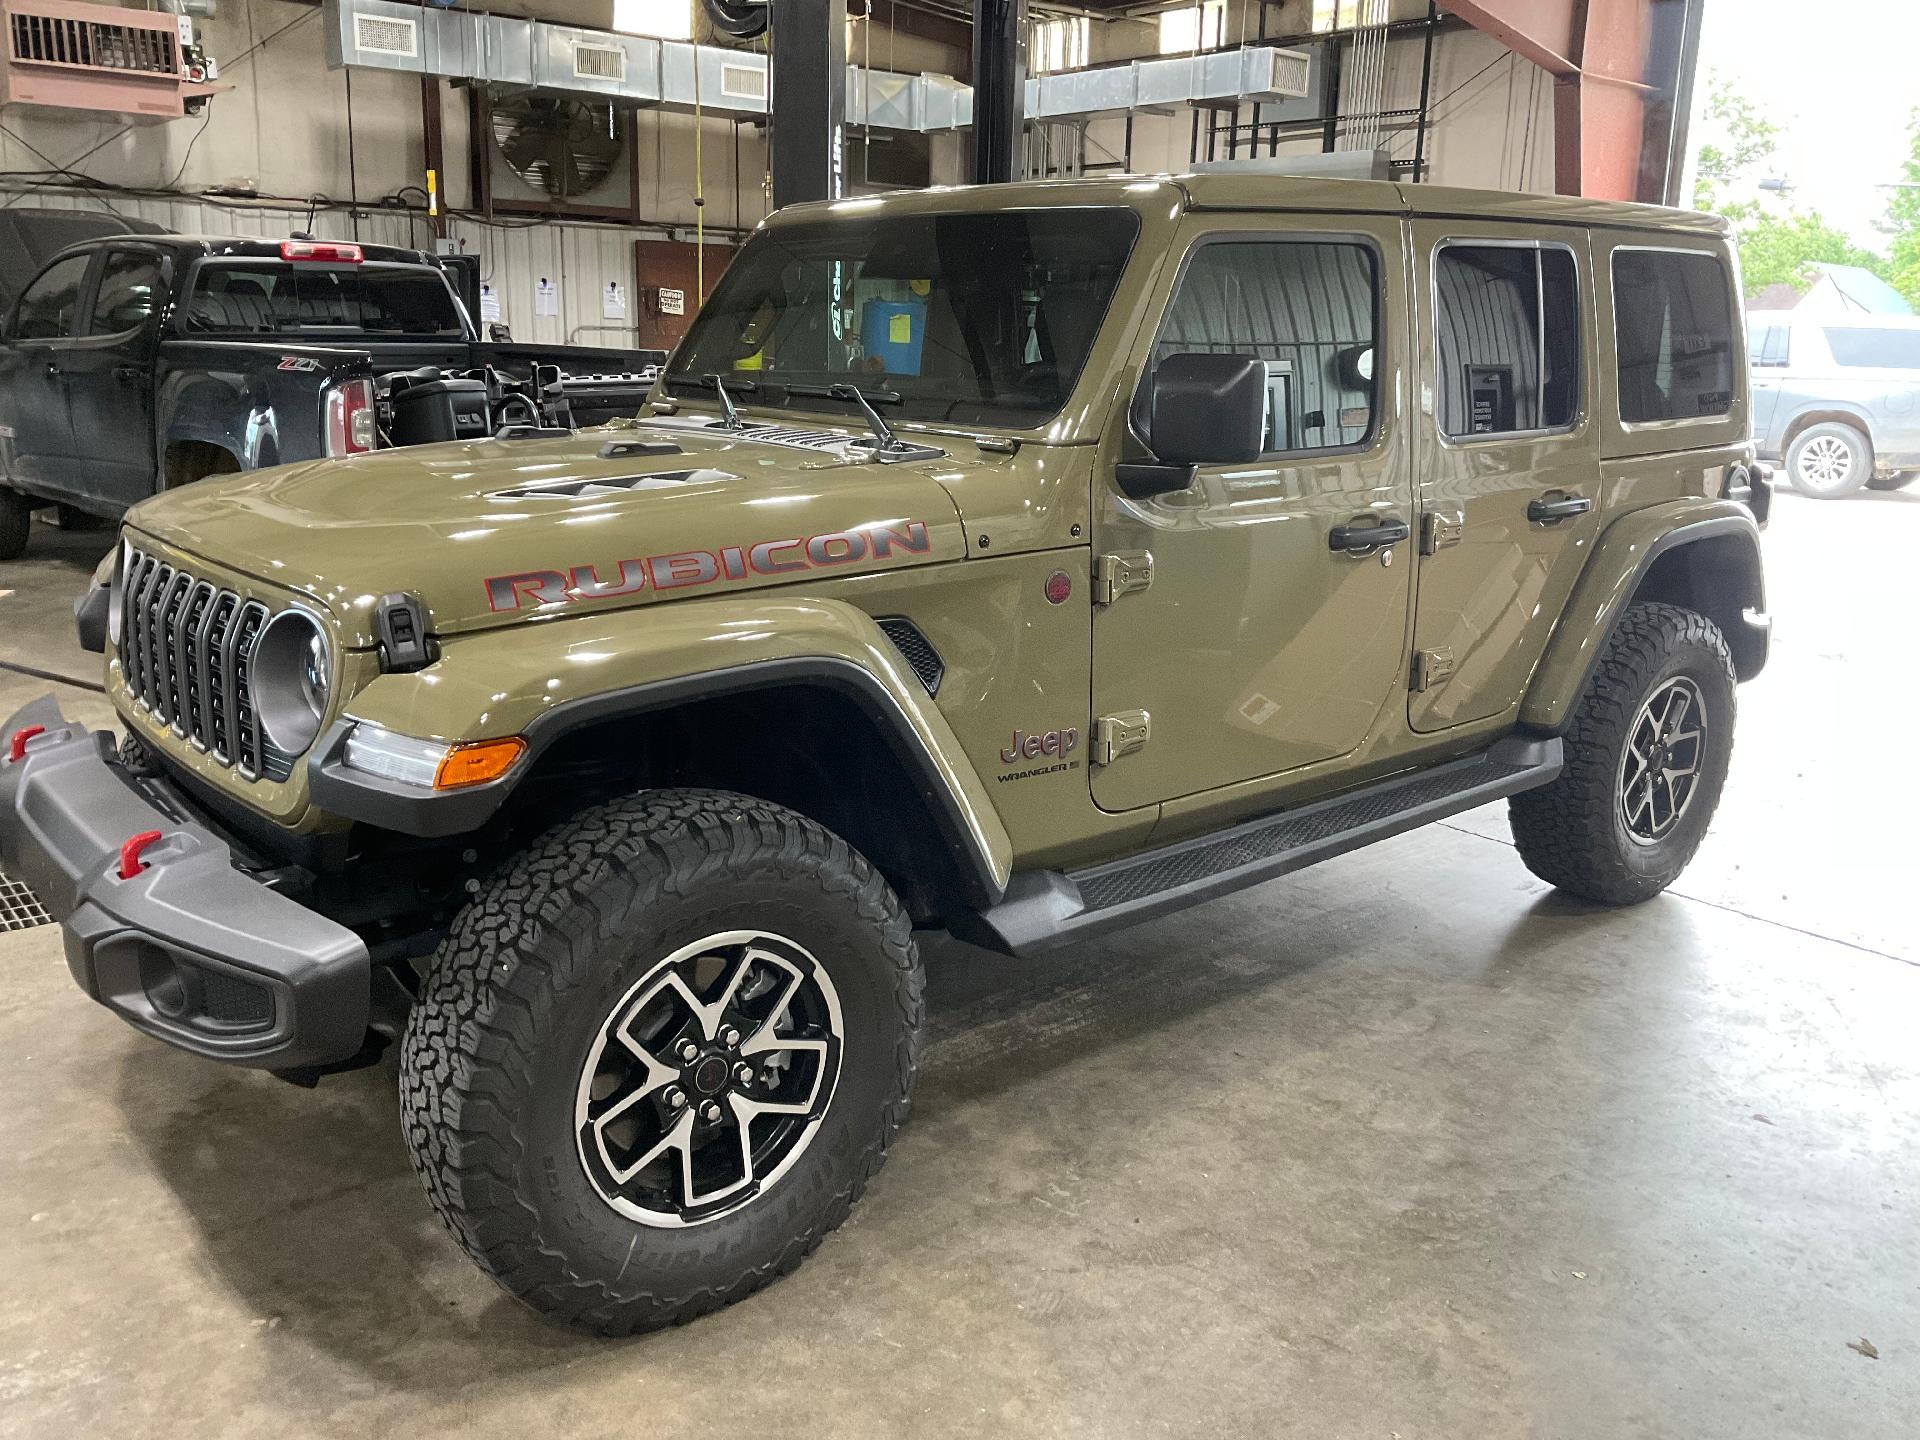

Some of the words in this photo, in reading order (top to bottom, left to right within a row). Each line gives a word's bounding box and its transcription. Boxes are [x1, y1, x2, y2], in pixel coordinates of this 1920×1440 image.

[661, 290, 682, 299] CAUTION
[277, 356, 321, 371] Z71
[484, 521, 931, 612] RUBICON
[1000, 727, 1079, 764] Jeep
[997, 763, 1067, 783] WRANGLER
